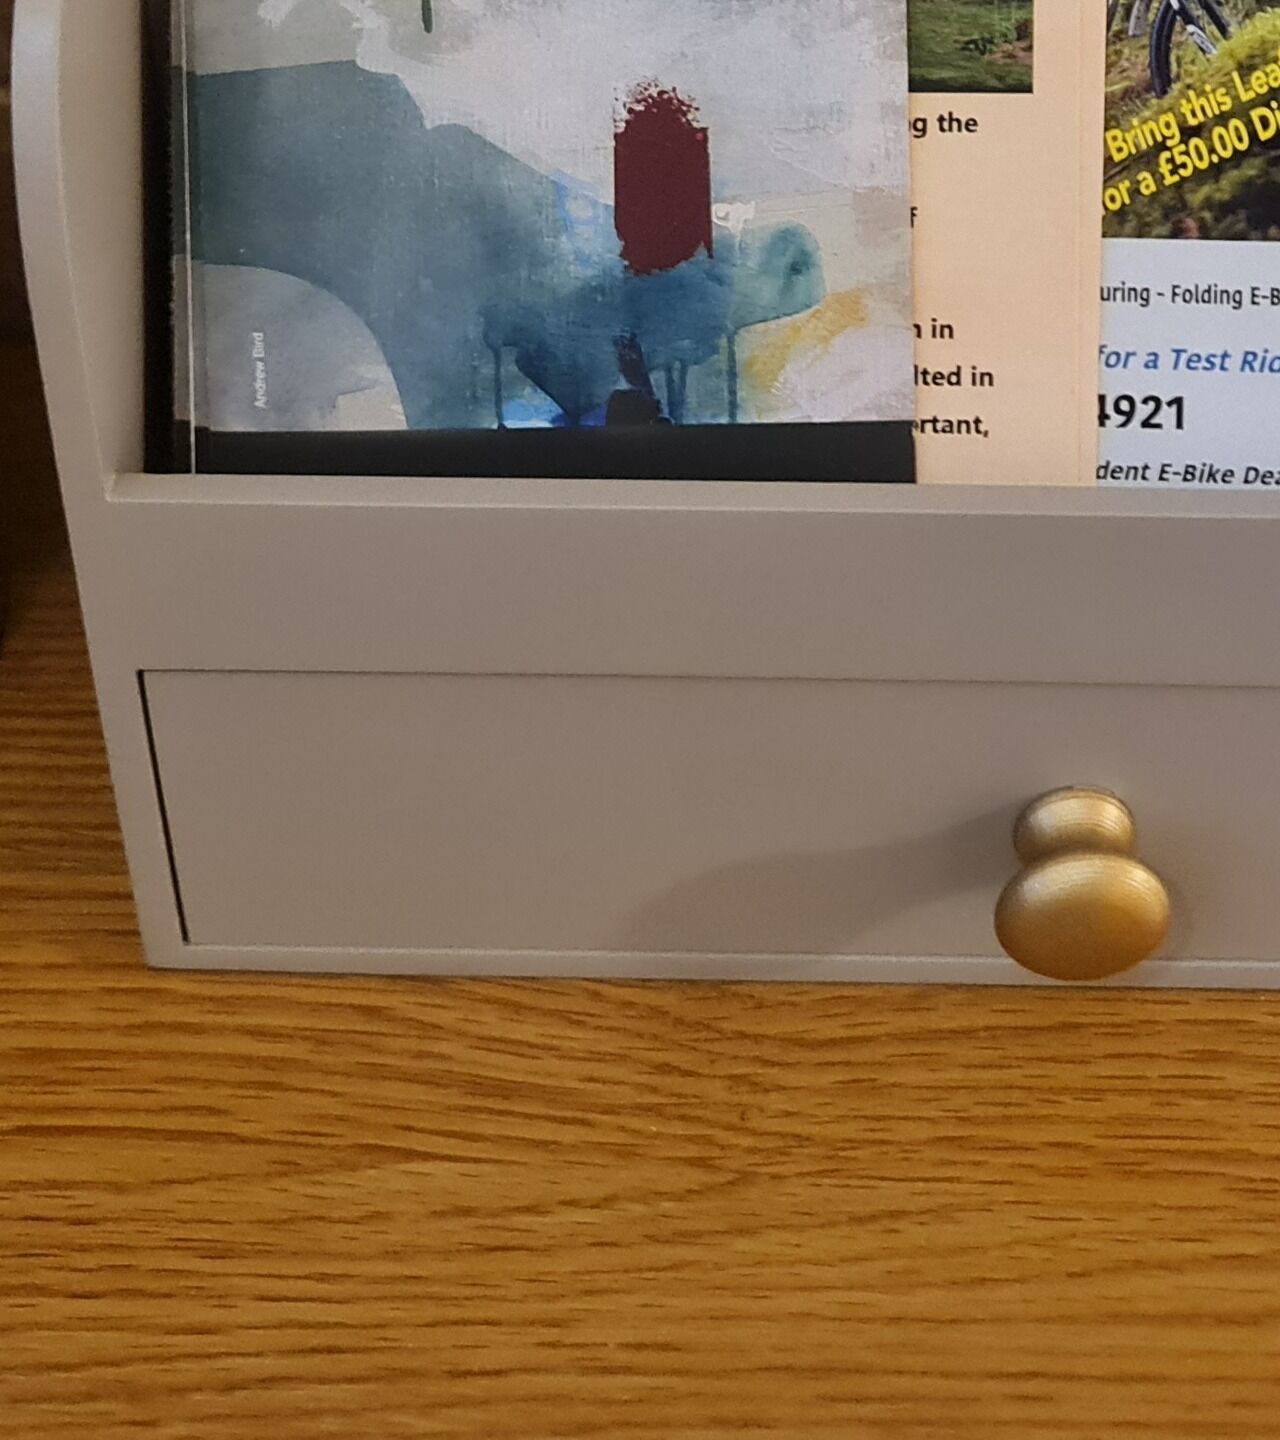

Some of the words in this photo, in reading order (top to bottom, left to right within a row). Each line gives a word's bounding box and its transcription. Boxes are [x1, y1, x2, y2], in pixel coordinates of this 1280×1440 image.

[936, 111, 978, 133] the
[1105, 111, 1181, 163] Bring
[1180, 84, 1232, 127] this
[1136, 171, 1157, 197] a
[1158, 117, 1250, 186] £50.00
[1100, 281, 1150, 307] uring
[1171, 284, 1243, 310] Folding
[931, 317, 954, 339] in
[1144, 351, 1159, 370] a
[1171, 348, 1231, 372] Test
[971, 366, 994, 388] in
[914, 415, 989, 438] rtant,
[1096, 460, 1150, 481] dent
[1158, 463, 1236, 485] E-Bike
